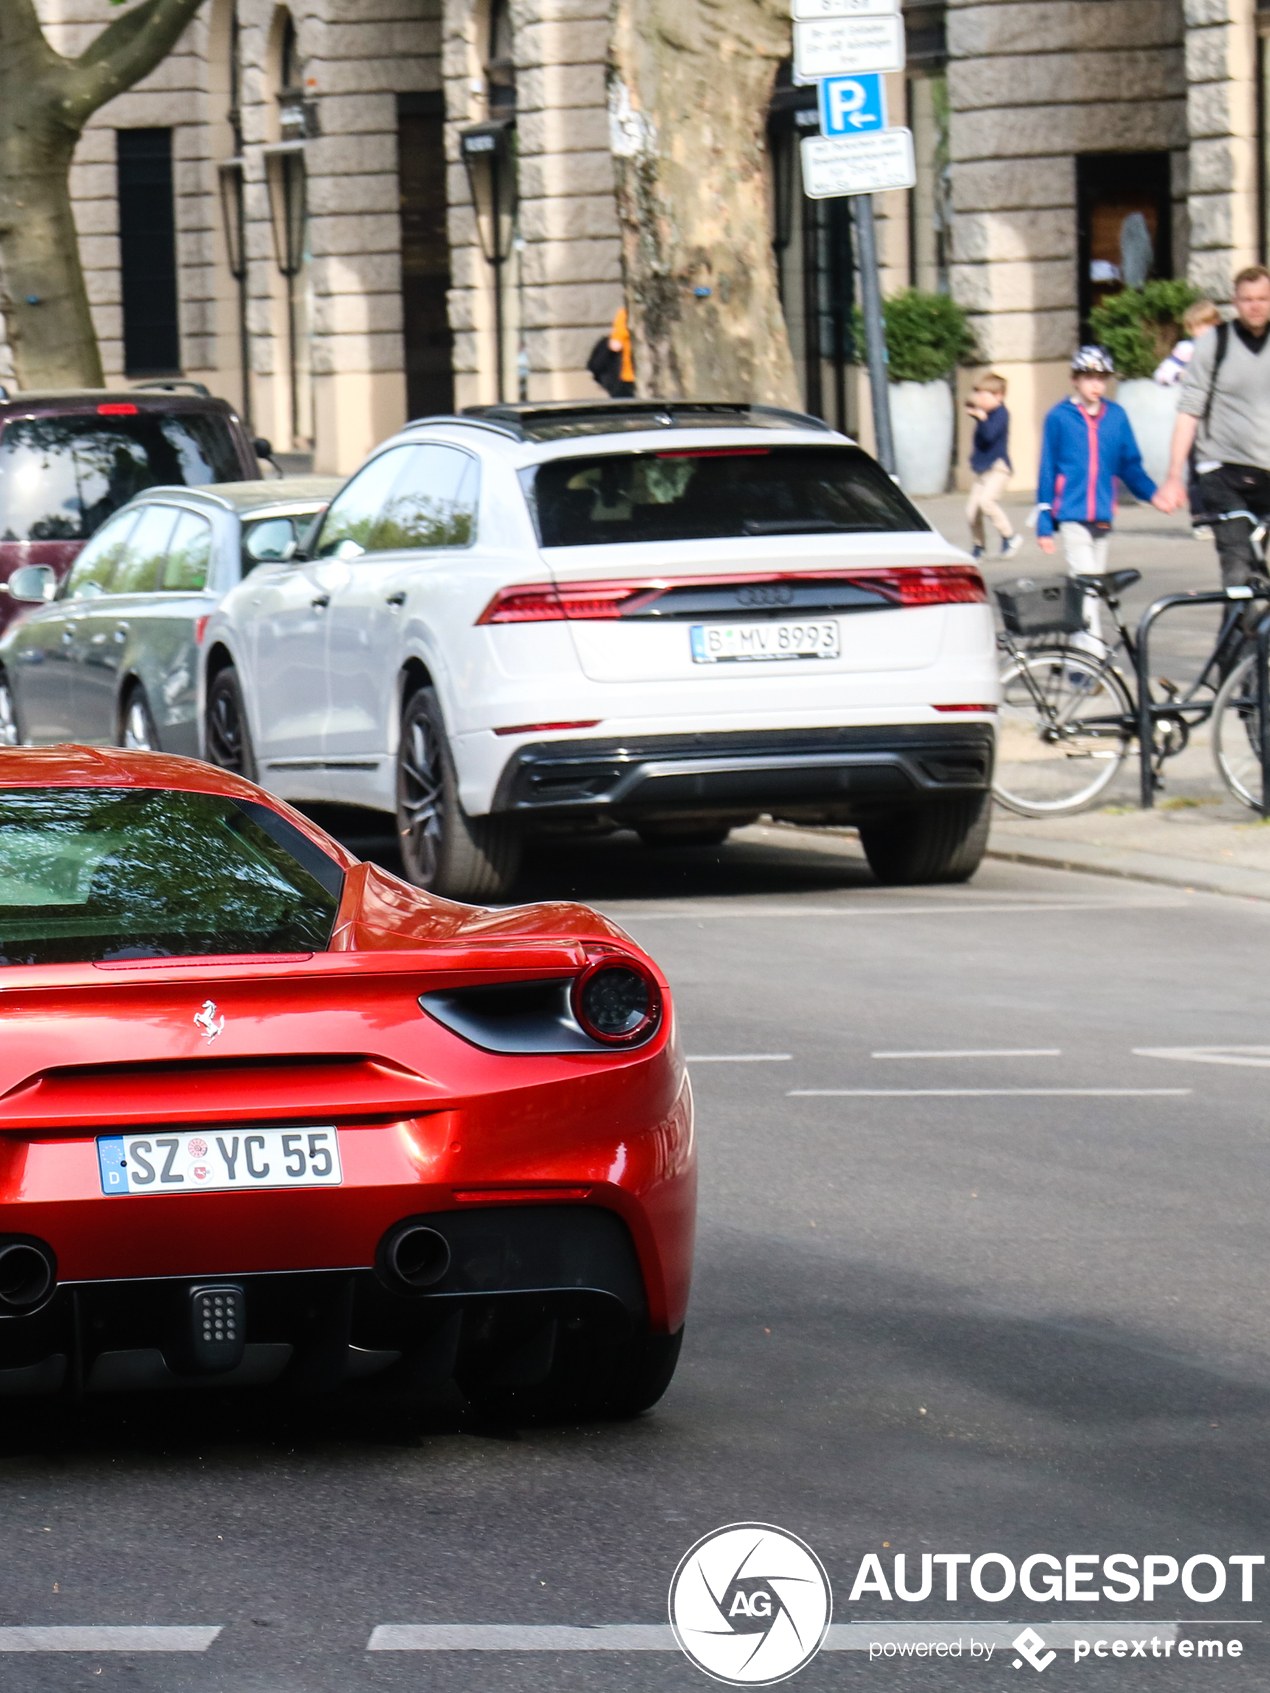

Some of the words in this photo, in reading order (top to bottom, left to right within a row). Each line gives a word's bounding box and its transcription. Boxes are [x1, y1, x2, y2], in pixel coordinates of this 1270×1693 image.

[828, 80, 866, 131] P
[708, 630, 723, 651] B
[740, 627, 769, 650] MV
[778, 626, 835, 649] 8993
[109, 1171, 121, 1185] D
[130, 1138, 184, 1185] SZ
[216, 1135, 270, 1180] YC
[281, 1133, 333, 1178] 55
